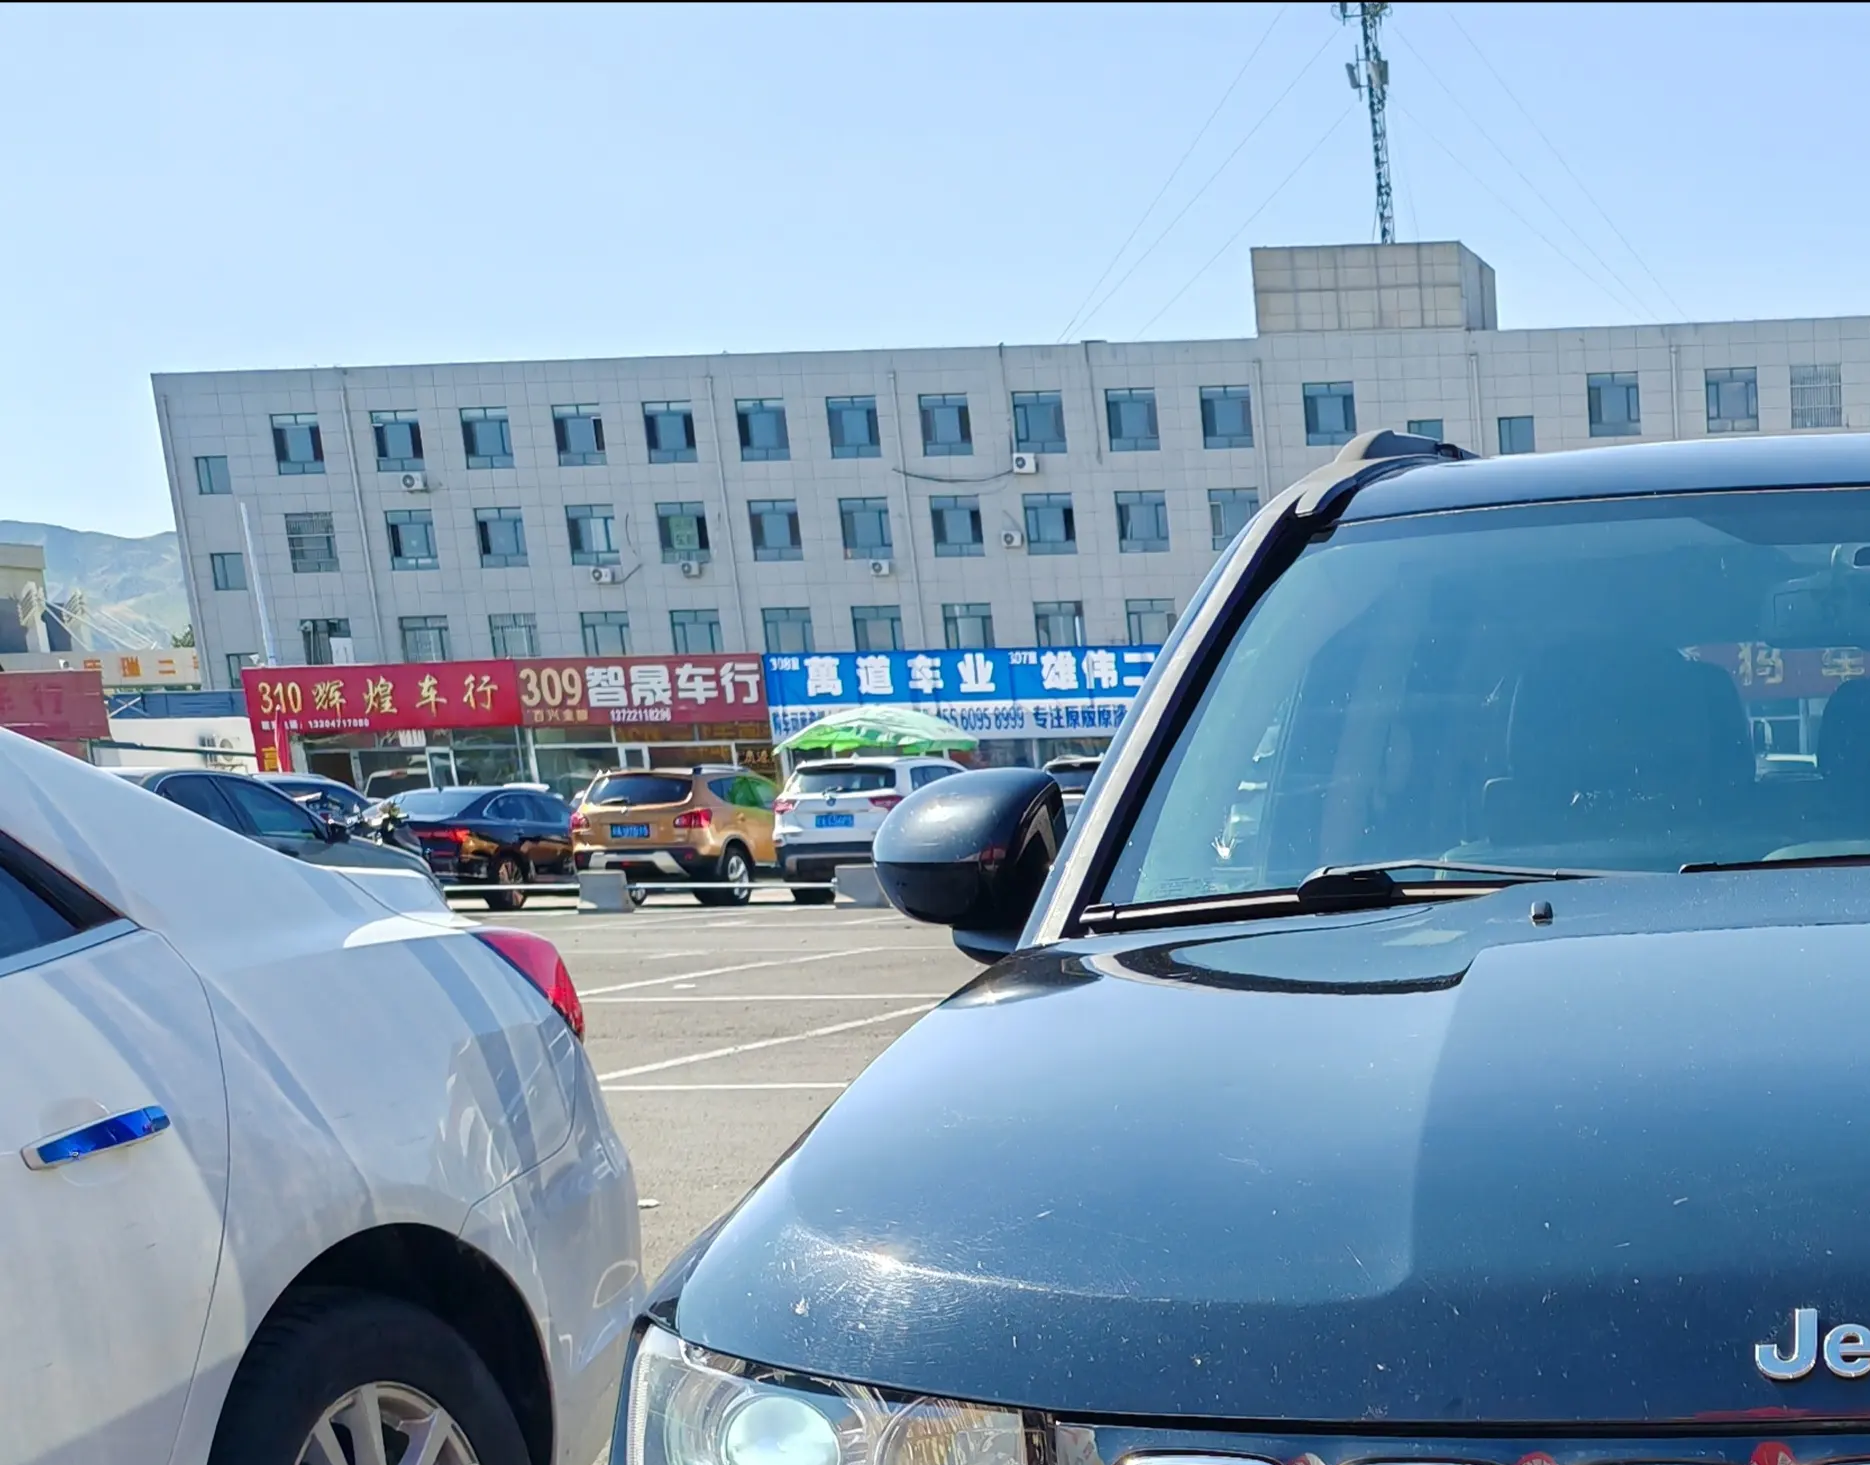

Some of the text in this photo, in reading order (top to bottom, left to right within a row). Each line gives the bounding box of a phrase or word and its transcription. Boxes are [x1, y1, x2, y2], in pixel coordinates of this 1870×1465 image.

[258, 673, 498, 720] 310 辉煌车行
[519, 661, 761, 708] 309 智晟车行
[803, 652, 996, 697] 萬道车业
